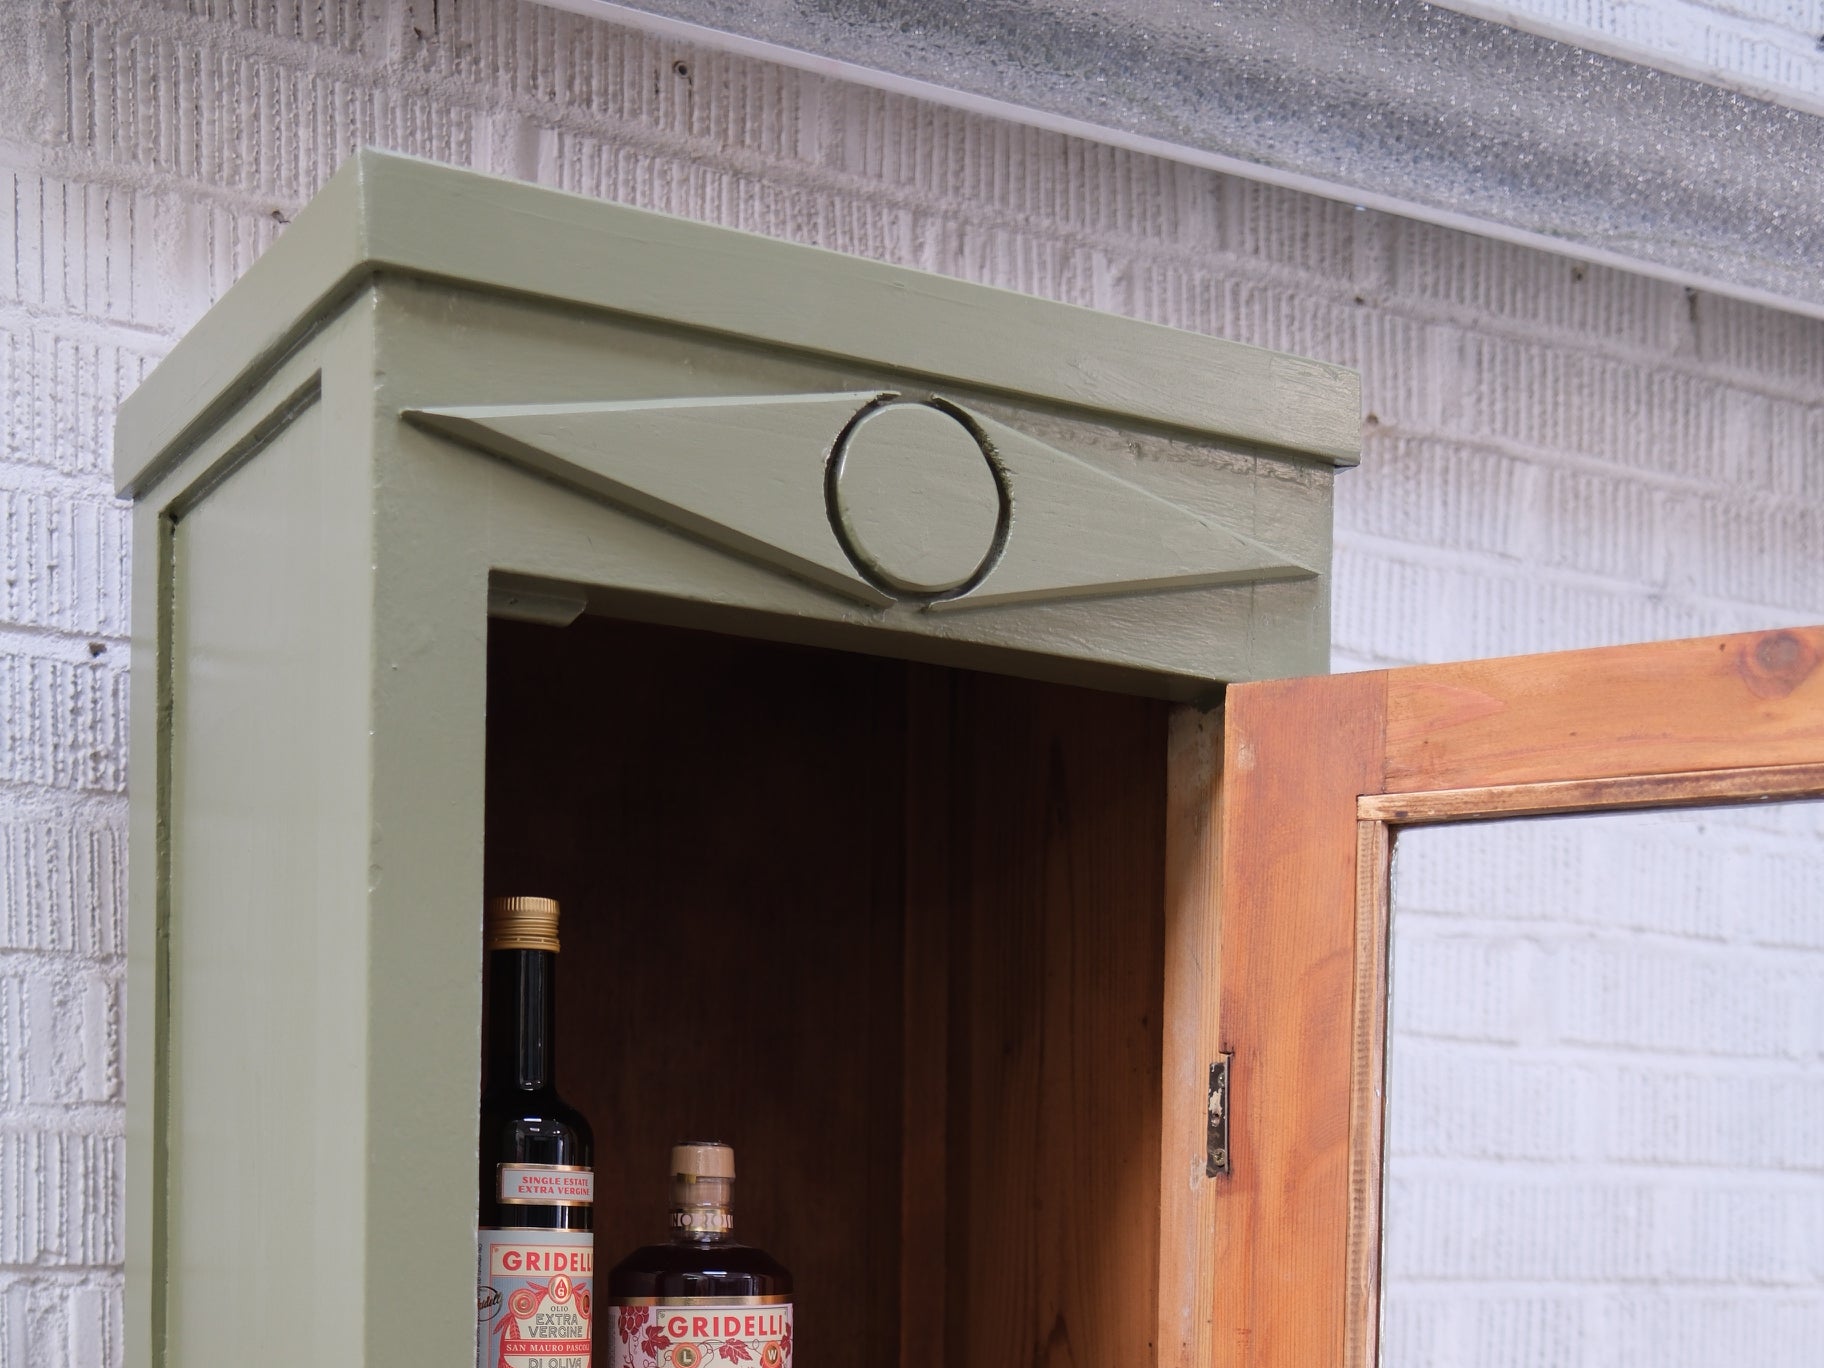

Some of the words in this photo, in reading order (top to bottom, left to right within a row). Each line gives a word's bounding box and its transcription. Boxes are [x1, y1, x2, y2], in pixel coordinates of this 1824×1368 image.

[522, 1176, 561, 1184] SINGLE
[563, 1178, 589, 1187] ESTATE
[518, 1186, 554, 1194] EXTRA
[558, 1187, 591, 1196] VERGINE
[536, 1314, 578, 1326] EXTRA
[528, 1326, 583, 1338] VERGINE
[667, 1315, 783, 1338] GRIDELLI
[506, 1344, 527, 1352] SAN
